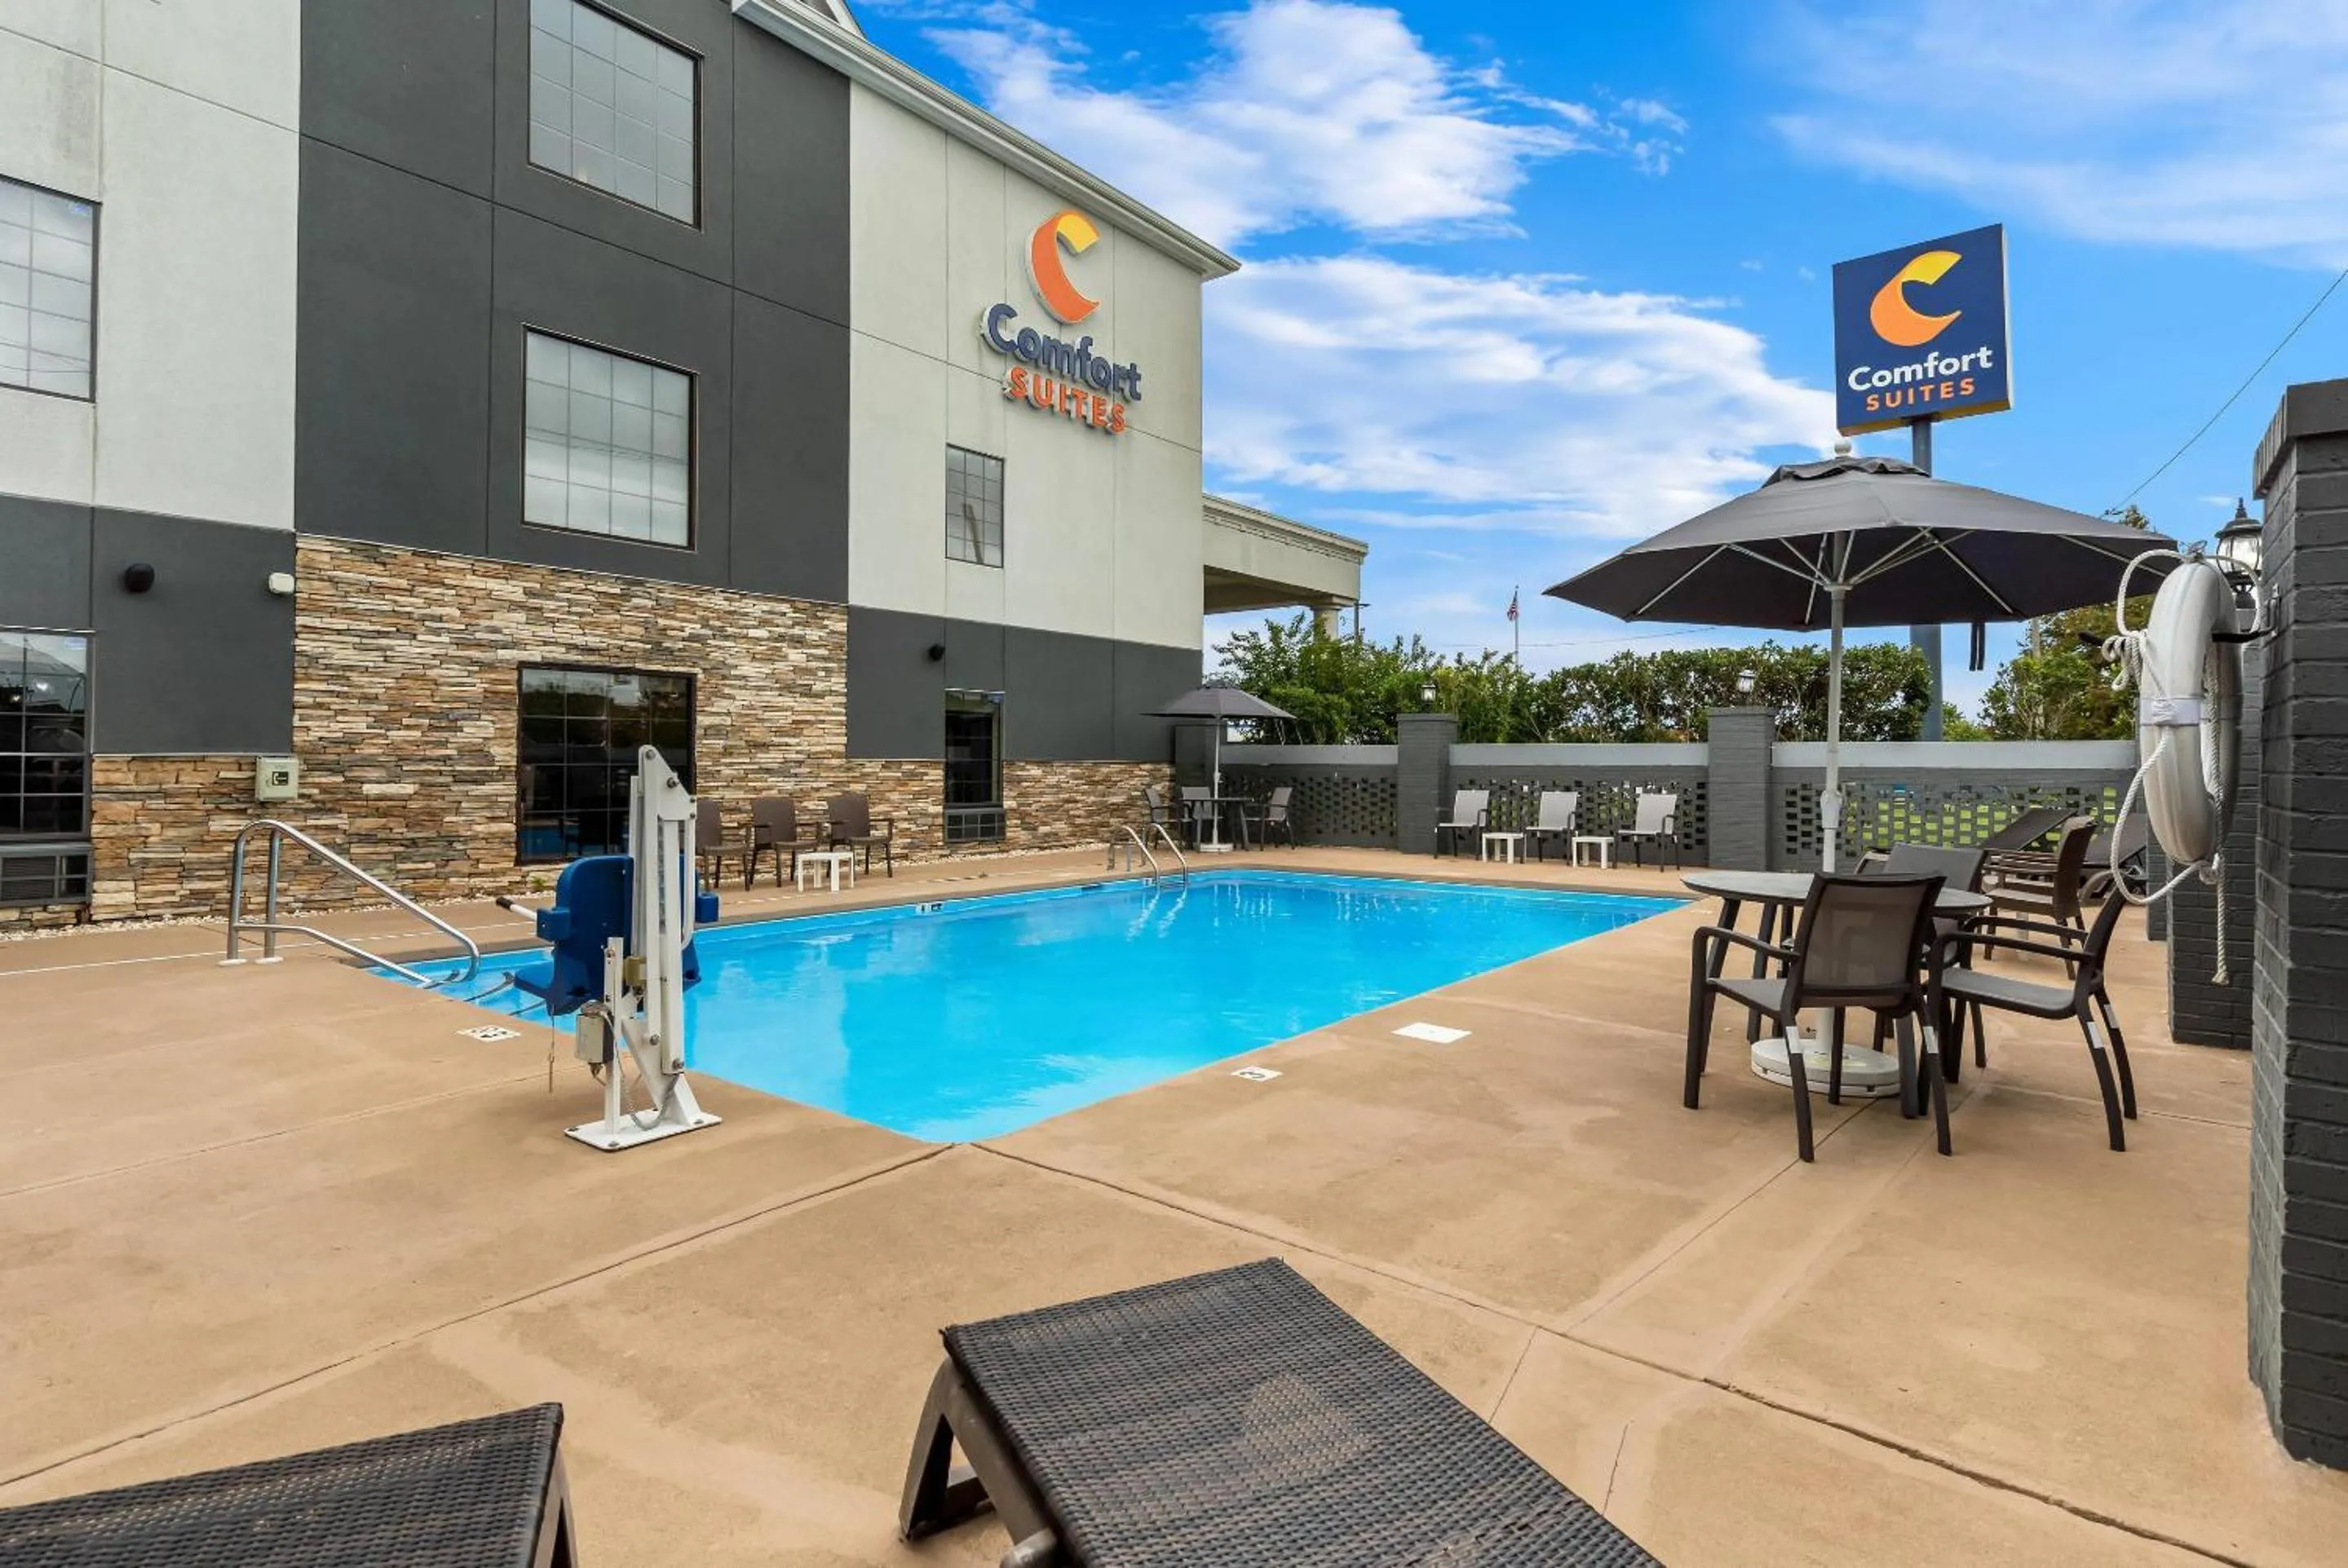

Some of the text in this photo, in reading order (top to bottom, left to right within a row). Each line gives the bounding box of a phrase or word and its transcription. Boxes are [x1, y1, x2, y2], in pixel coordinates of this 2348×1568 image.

[981, 303, 1142, 402] Comfort
[1848, 347, 1992, 391] Comfort
[1005, 366, 1125, 434] SUITES
[1866, 378, 1975, 411] SUITES
